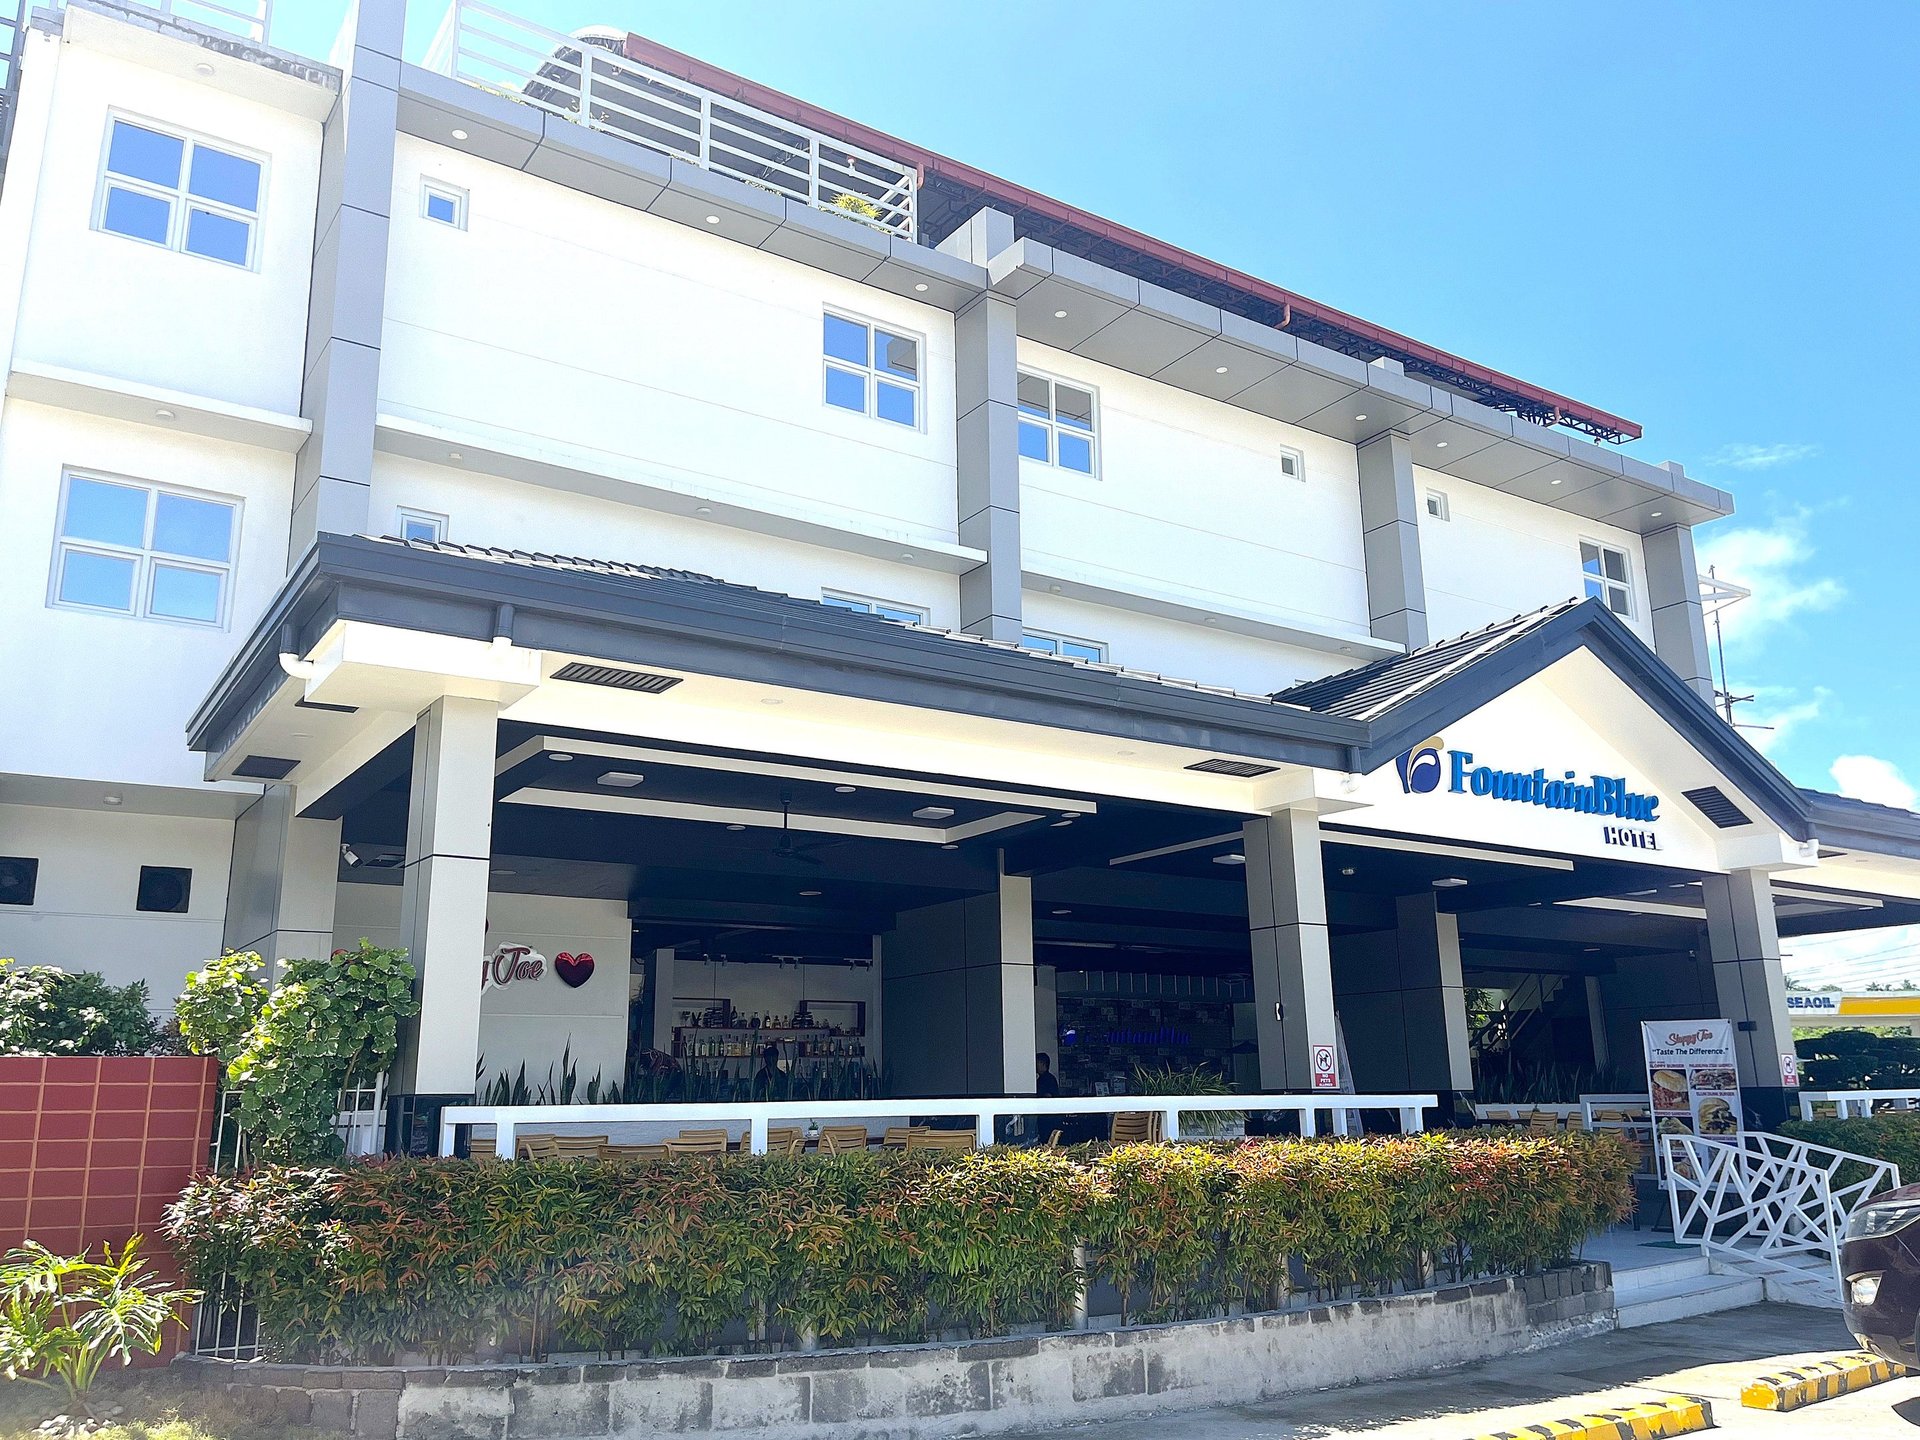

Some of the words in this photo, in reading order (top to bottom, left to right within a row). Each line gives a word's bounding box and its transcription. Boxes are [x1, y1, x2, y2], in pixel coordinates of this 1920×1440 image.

[1447, 750, 1660, 822] FountainBlue
[1603, 826, 1662, 850] HOTEL
[493, 946, 544, 986] Joe
[1787, 996, 1835, 1009] SEAOIL
